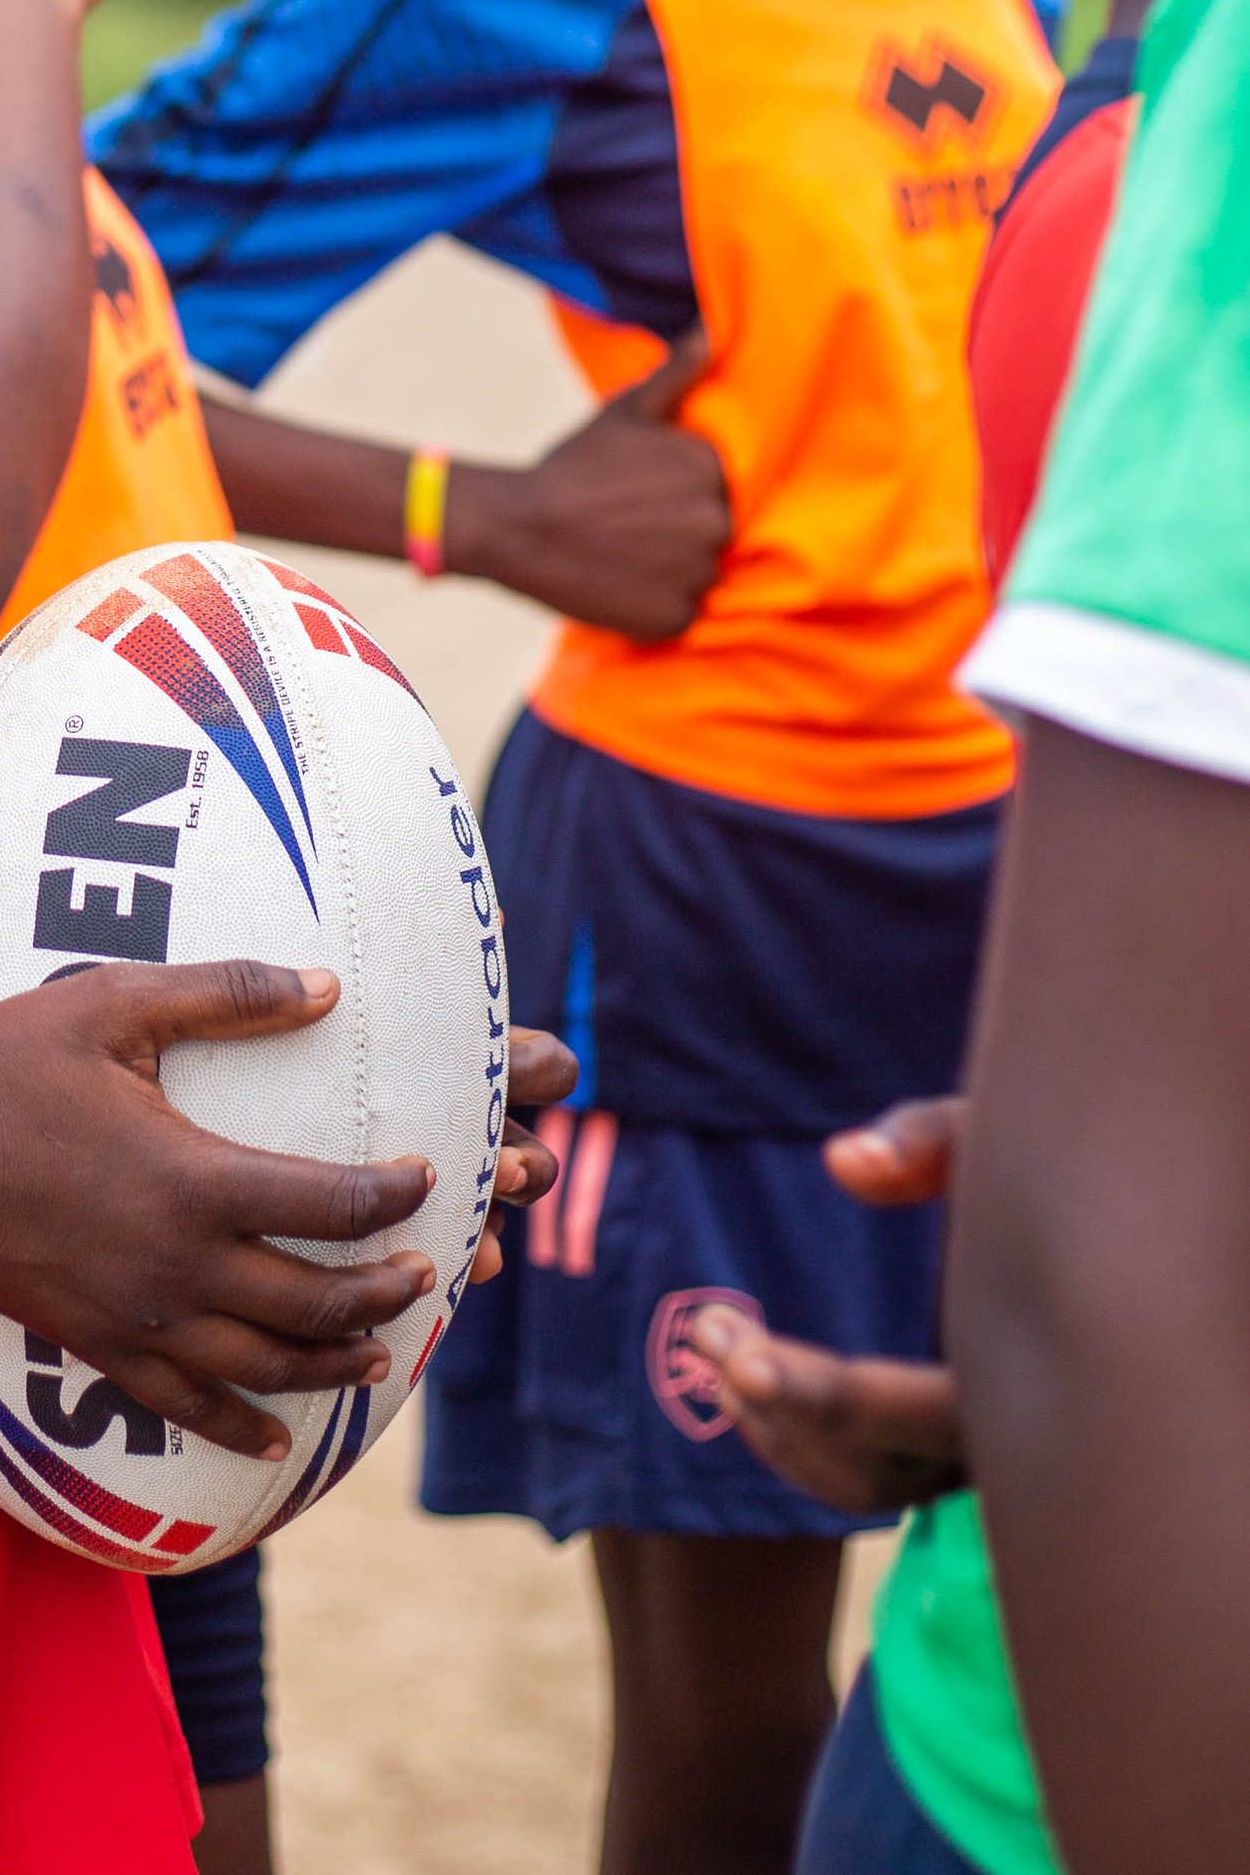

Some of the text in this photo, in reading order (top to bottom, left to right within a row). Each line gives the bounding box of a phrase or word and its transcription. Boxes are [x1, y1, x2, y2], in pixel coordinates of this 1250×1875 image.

[271, 670, 291, 706] DEVICE
[285, 710, 304, 749] STRIPE
[298, 754, 310, 775] THE
[185, 749, 210, 829] Est. 1958
[429, 766, 504, 1313] Autotrader
[168, 1424, 184, 1455] SIZE
